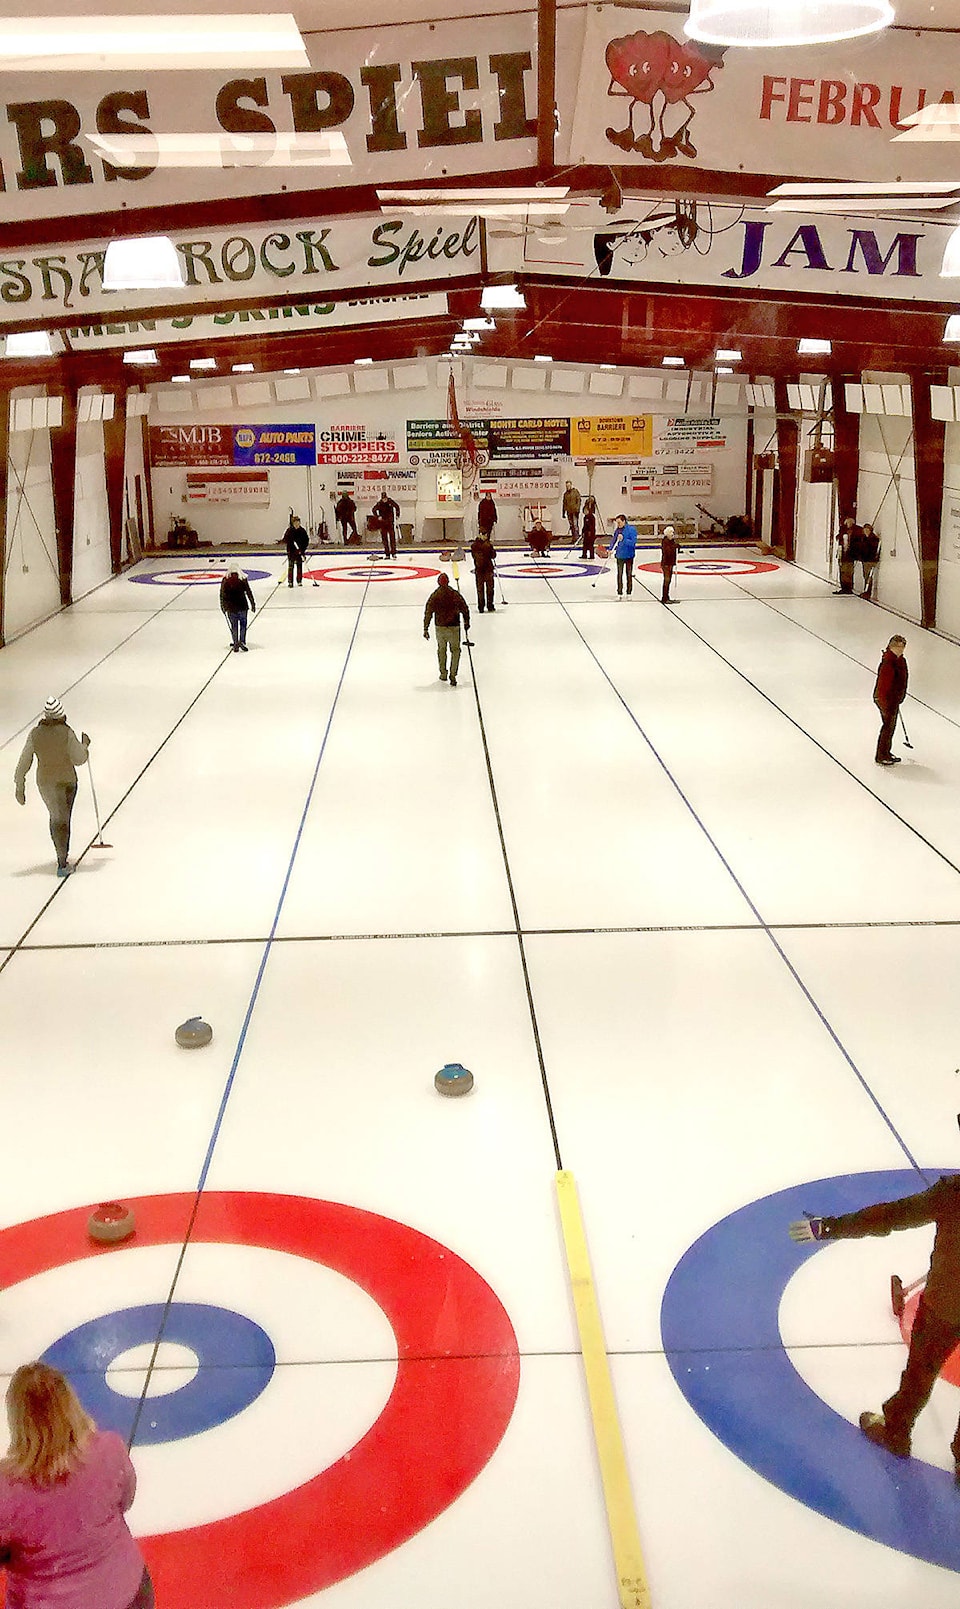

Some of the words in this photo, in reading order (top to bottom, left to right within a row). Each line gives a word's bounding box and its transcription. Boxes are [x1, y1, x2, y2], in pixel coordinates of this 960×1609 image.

[0, 90, 159, 192] RS
[215, 51, 538, 168] SPIEL
[721, 221, 926, 278] JAM
[0, 228, 340, 308] SHAROCK
[367, 215, 479, 274] Spiel
[490, 420, 517, 428] MONTE
[517, 420, 543, 428] CARLO
[544, 419, 569, 427] MOTEL
[597, 423, 626, 431] BARRIERE
[179, 426, 222, 443] MJB
[259, 432, 285, 444] AUTO
[285, 431, 314, 443] PARTS
[320, 431, 366, 442] CRIME
[320, 441, 395, 452] STOPPERS
[322, 453, 395, 463] 1-800-222-8477
